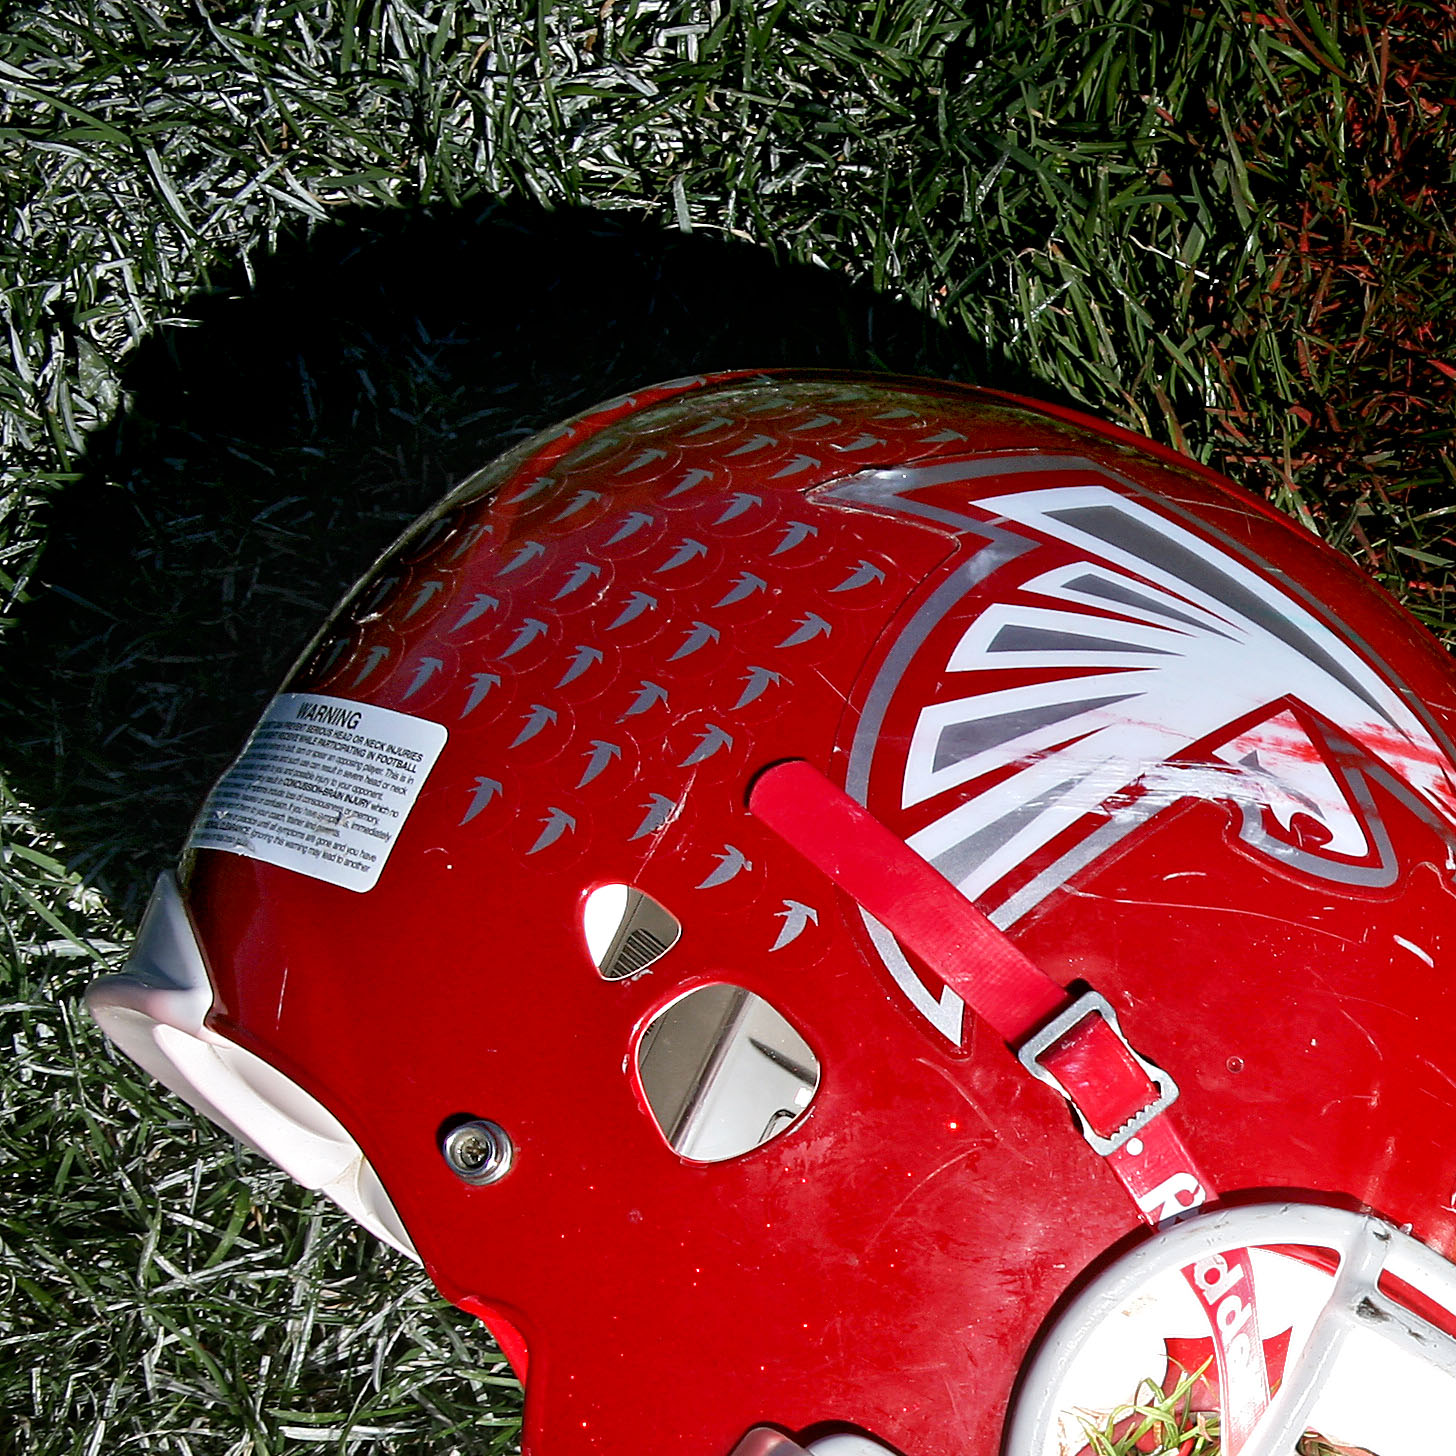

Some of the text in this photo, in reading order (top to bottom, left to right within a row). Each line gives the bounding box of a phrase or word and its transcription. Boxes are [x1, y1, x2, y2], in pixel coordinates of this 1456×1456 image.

[294, 700, 364, 730] WARNING
[331, 729, 353, 741] HEAD
[351, 734, 365, 744] OR
[363, 737, 388, 751] NECK
[384, 743, 424, 762] INJURIES
[365, 750, 376, 760] IN
[374, 753, 418, 773] FOOTBALL
[335, 780, 352, 791] your
[363, 775, 383, 787] head
[381, 781, 390, 789] or
[389, 783, 409, 795] neck
[384, 768, 400, 780] This
[398, 773, 407, 782] is
[405, 775, 415, 784] in
[343, 793, 370, 808] INJURY
[389, 809, 399, 818] no
[358, 849, 377, 862] have
